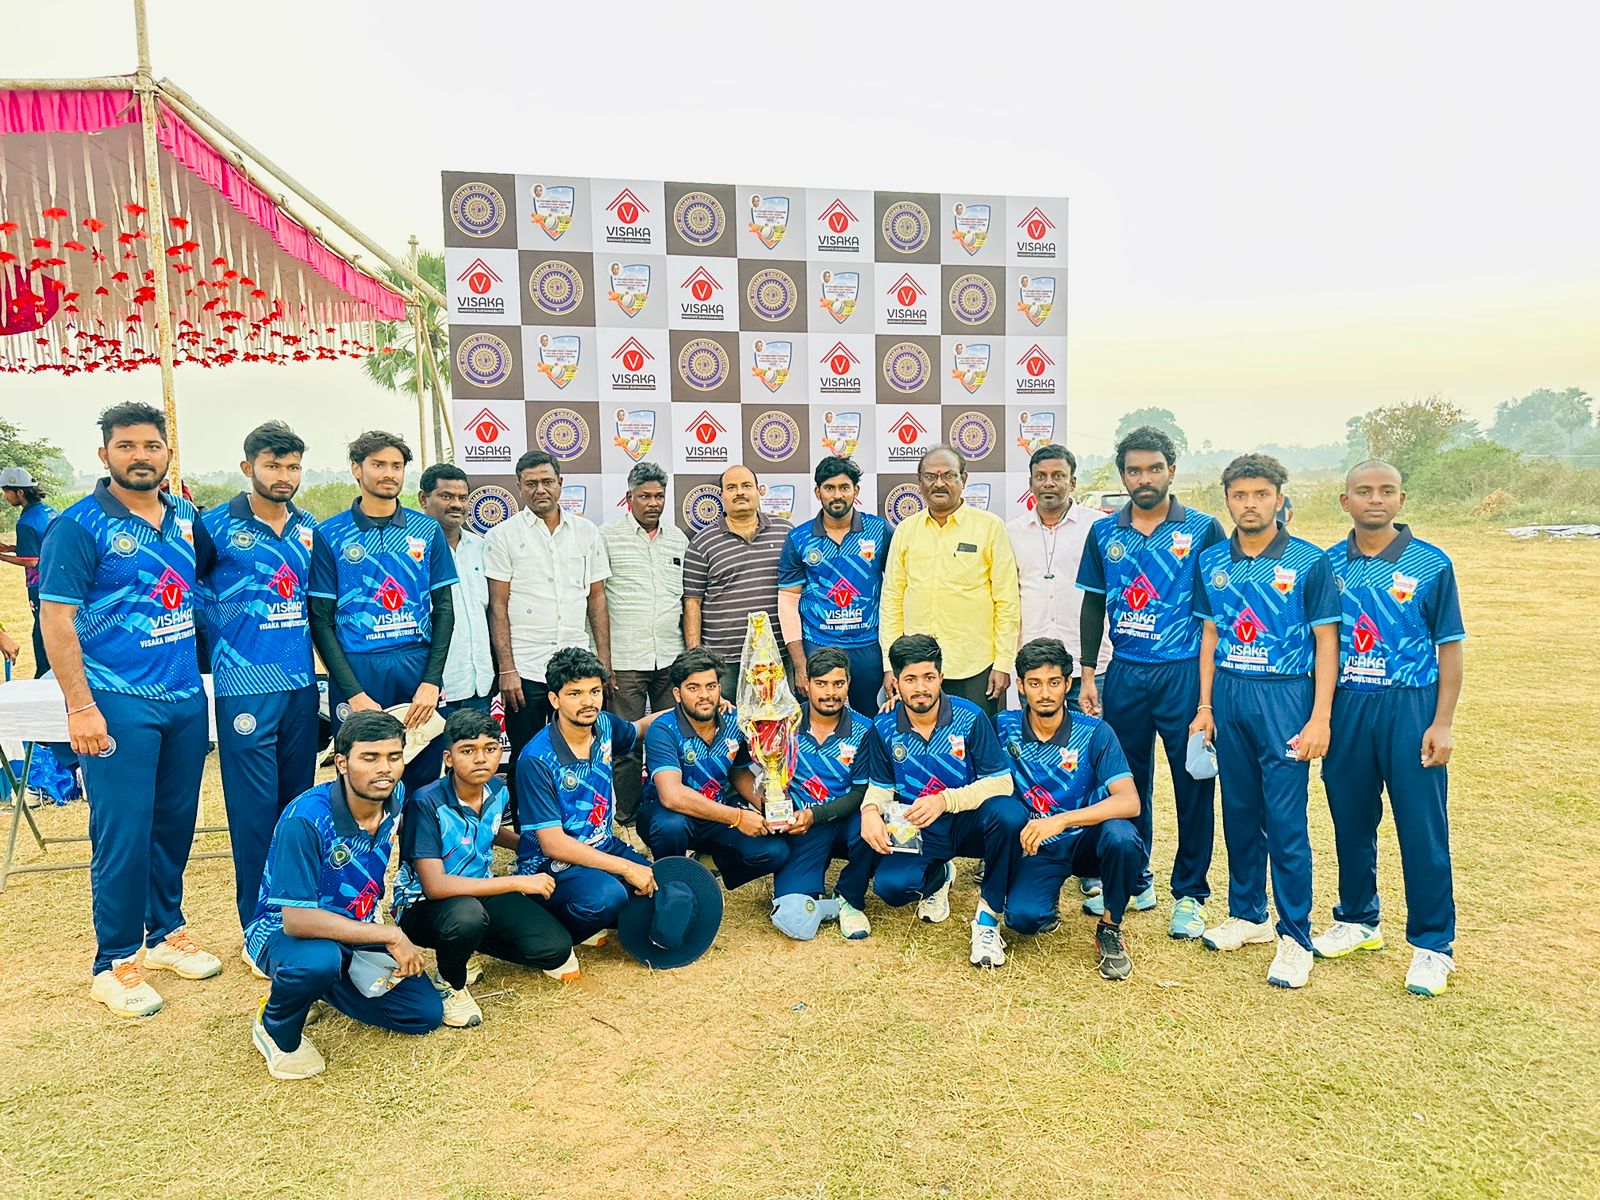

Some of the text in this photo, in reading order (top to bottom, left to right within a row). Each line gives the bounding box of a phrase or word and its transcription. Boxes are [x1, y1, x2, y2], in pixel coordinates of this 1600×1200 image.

[621, 205, 635, 222] V
[832, 216, 845, 231] V
[1031, 224, 1043, 237] V
[606, 226, 651, 237] VISAKA
[817, 235, 860, 245] VISAKA
[1016, 242, 1056, 251] VISAKA
[473, 276, 487, 293] V
[695, 284, 708, 299] V
[457, 297, 505, 307] VISAKA
[901, 289, 914, 304] V
[680, 304, 725, 314] VISAKA
[886, 309, 927, 318] VISAKA
[627, 354, 640, 369] V
[834, 358, 846, 372] V
[1030, 360, 1042, 374] V
[611, 374, 657, 383] VISAKA
[820, 377, 861, 387] VISAKA
[1016, 379, 1055, 388] VISAKA
[479, 425, 493, 441] V
[699, 427, 712, 441] V
[902, 428, 914, 442] V
[464, 446, 511, 455] VISAKA
[685, 446, 728, 456] VISAKA
[888, 447, 928, 456] VISAKA
[282, 580, 291, 596] V
[165, 587, 178, 606] V
[385, 593, 398, 608] V
[836, 591, 849, 605] V
[1133, 591, 1145, 607] V
[149, 608, 193, 629] VISAKA
[824, 608, 863, 619] VISAKA
[1241, 624, 1254, 640] V
[140, 636, 164, 648] VISAKA
[1356, 633, 1370, 650] V
[811, 786, 823, 800] V
[1036, 796, 1045, 811] V
[361, 896, 372, 915] V
